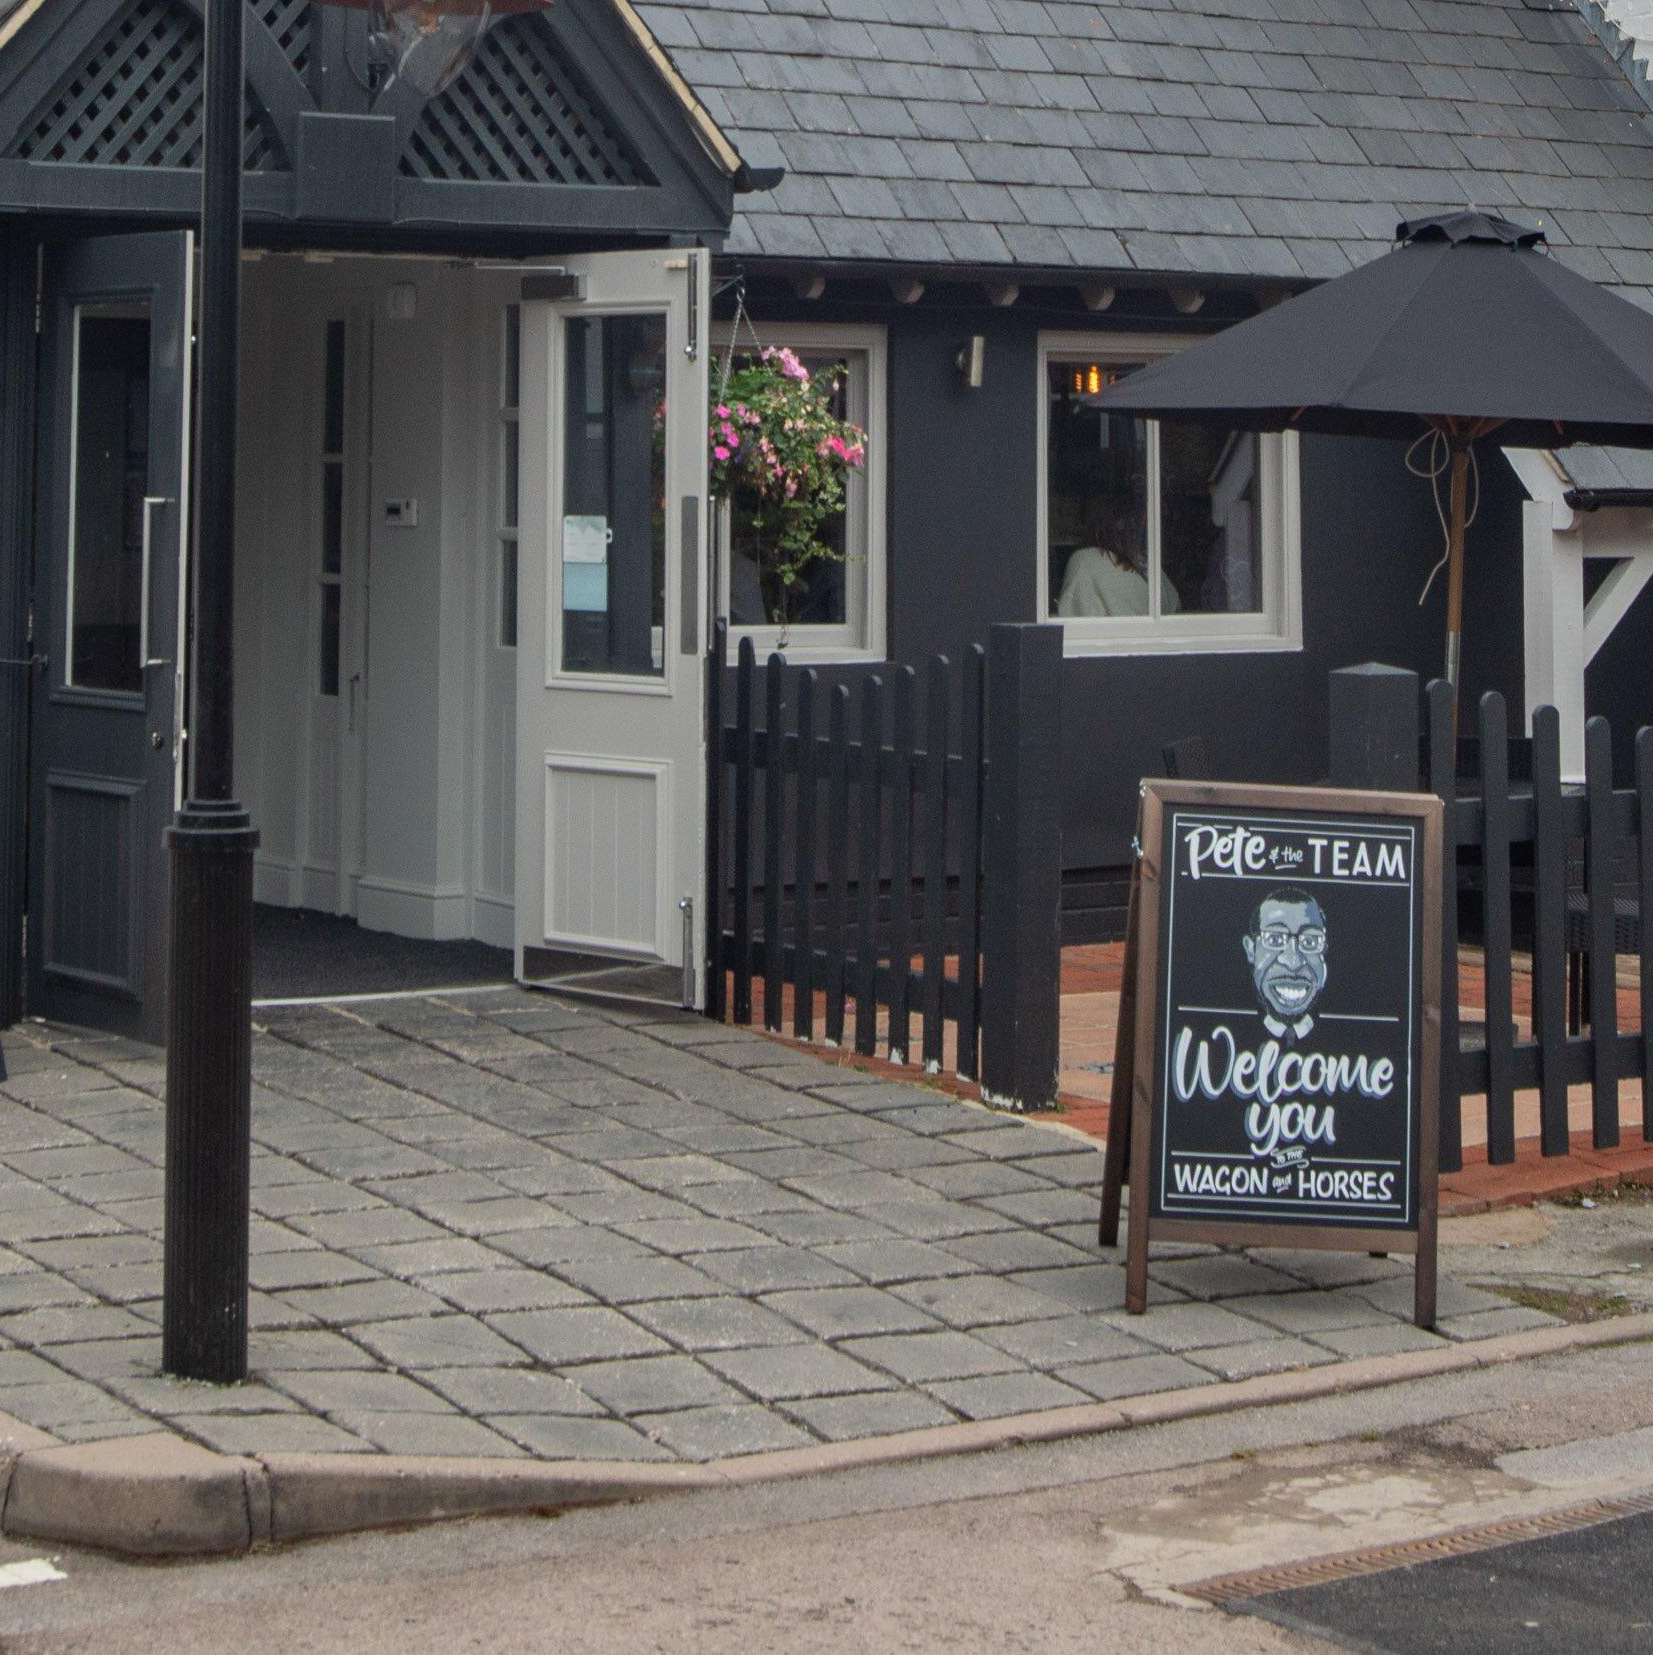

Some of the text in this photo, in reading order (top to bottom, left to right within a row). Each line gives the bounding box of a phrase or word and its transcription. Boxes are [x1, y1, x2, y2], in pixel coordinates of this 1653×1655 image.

[1184, 825, 1266, 880] Pete
[1283, 846, 1304, 863] the
[1308, 837, 1406, 879] TEAM
[1172, 1026, 1394, 1106] Welcome
[1244, 1101, 1337, 1156] you
[1174, 1163, 1395, 1200] WAGON and HORSES
